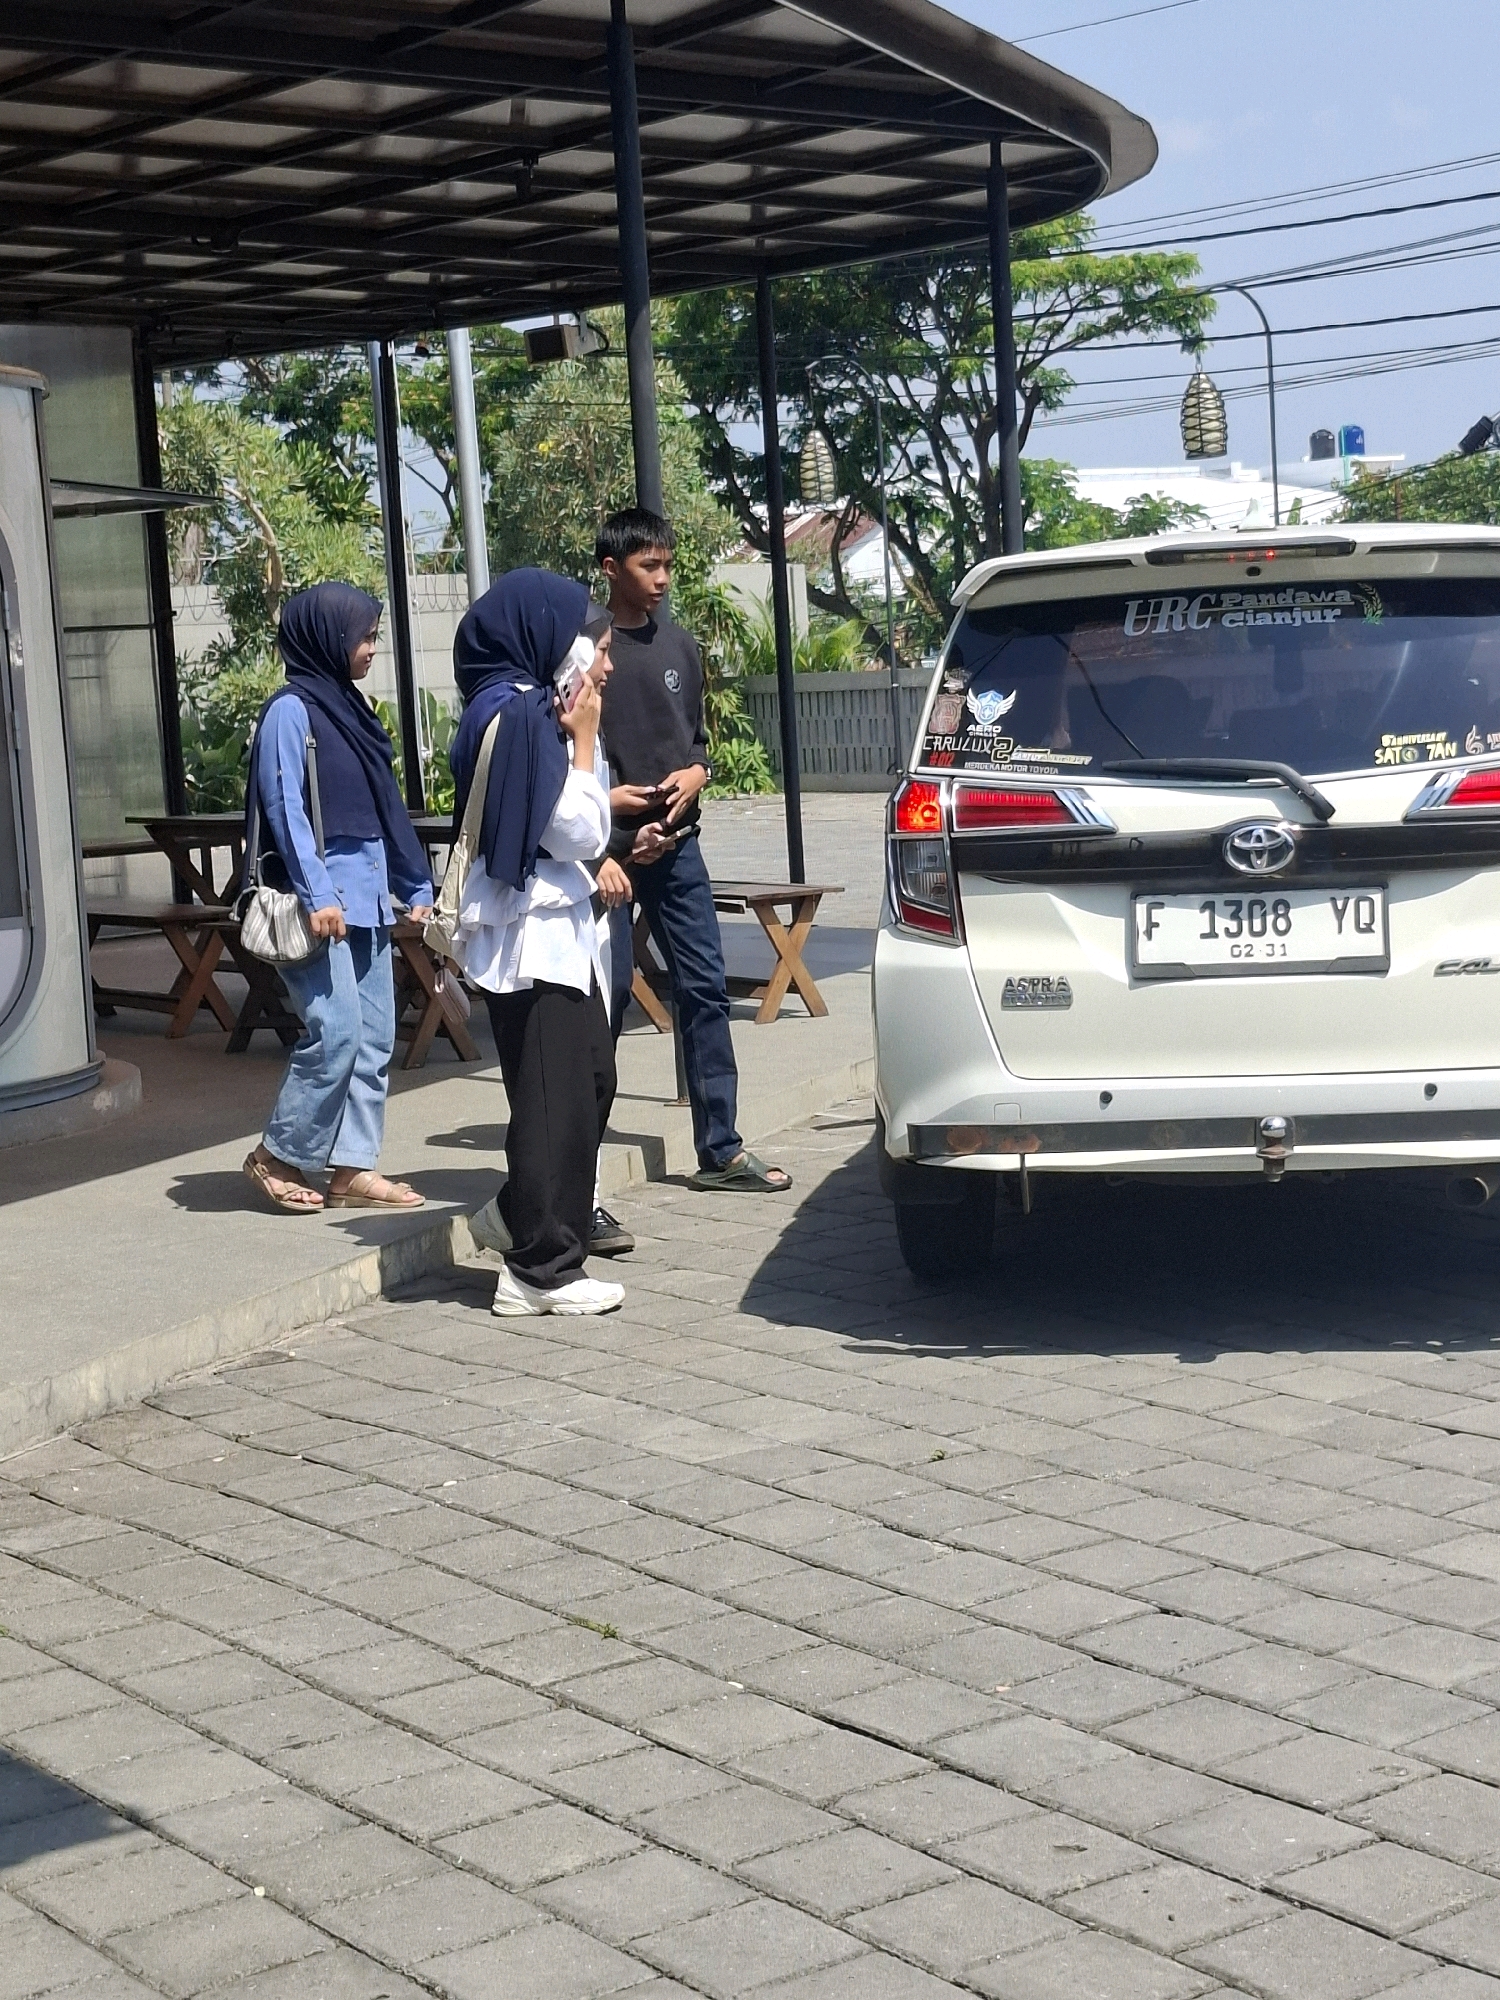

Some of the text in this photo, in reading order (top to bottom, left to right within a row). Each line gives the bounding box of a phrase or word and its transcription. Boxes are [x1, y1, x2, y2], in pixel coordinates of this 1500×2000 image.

[1123, 588, 1352, 637] URC Pandawa
[1221, 608, 1342, 628] Cianjur
[966, 724, 1003, 733] AERO
[1000, 763, 1029, 773] MOTOR
[1029, 765, 1059, 775] TOYOTA
[1144, 896, 1377, 941] F 1308 YQ
